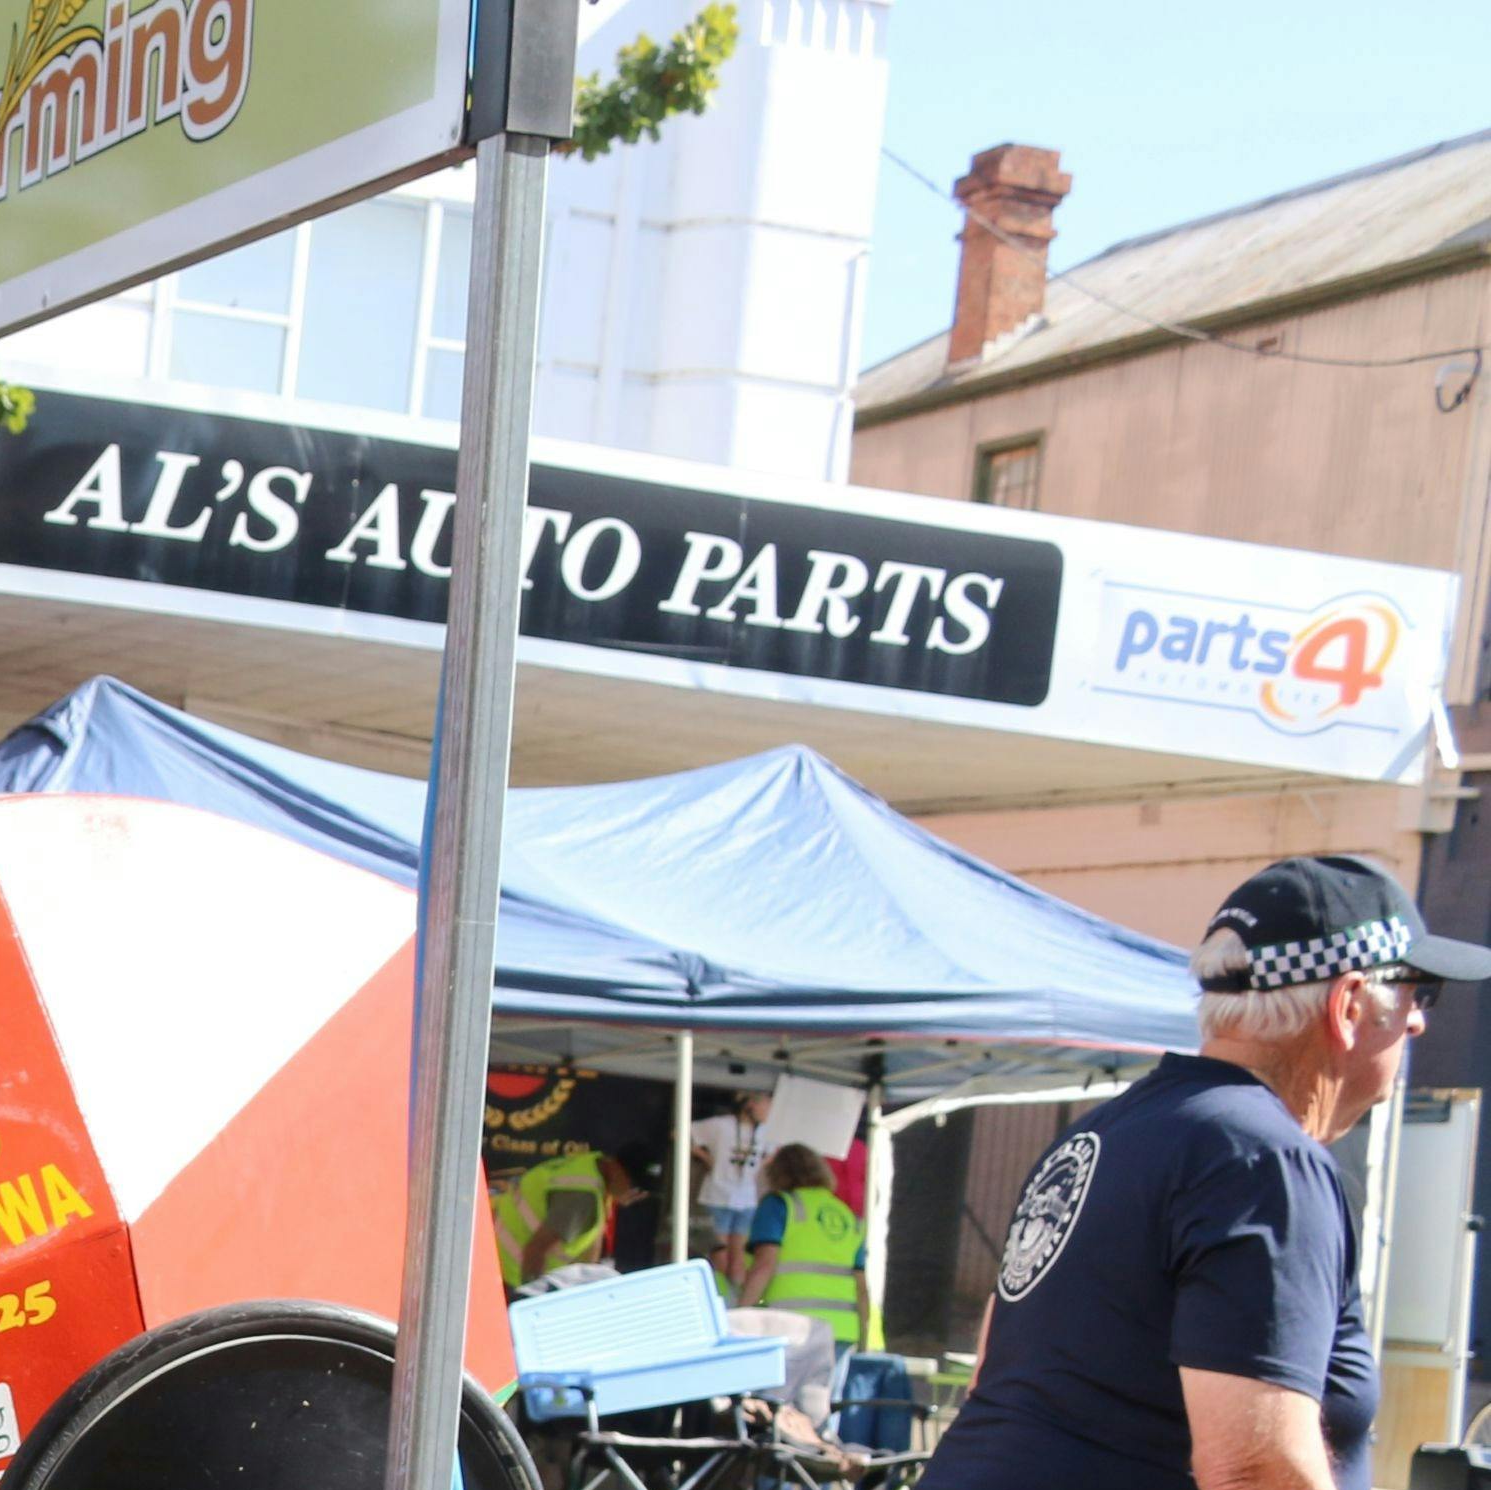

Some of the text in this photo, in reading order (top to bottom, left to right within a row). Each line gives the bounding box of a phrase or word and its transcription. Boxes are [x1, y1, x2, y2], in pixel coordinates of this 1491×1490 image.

[44, 443, 1007, 655] AL'S AUTO PARTS
